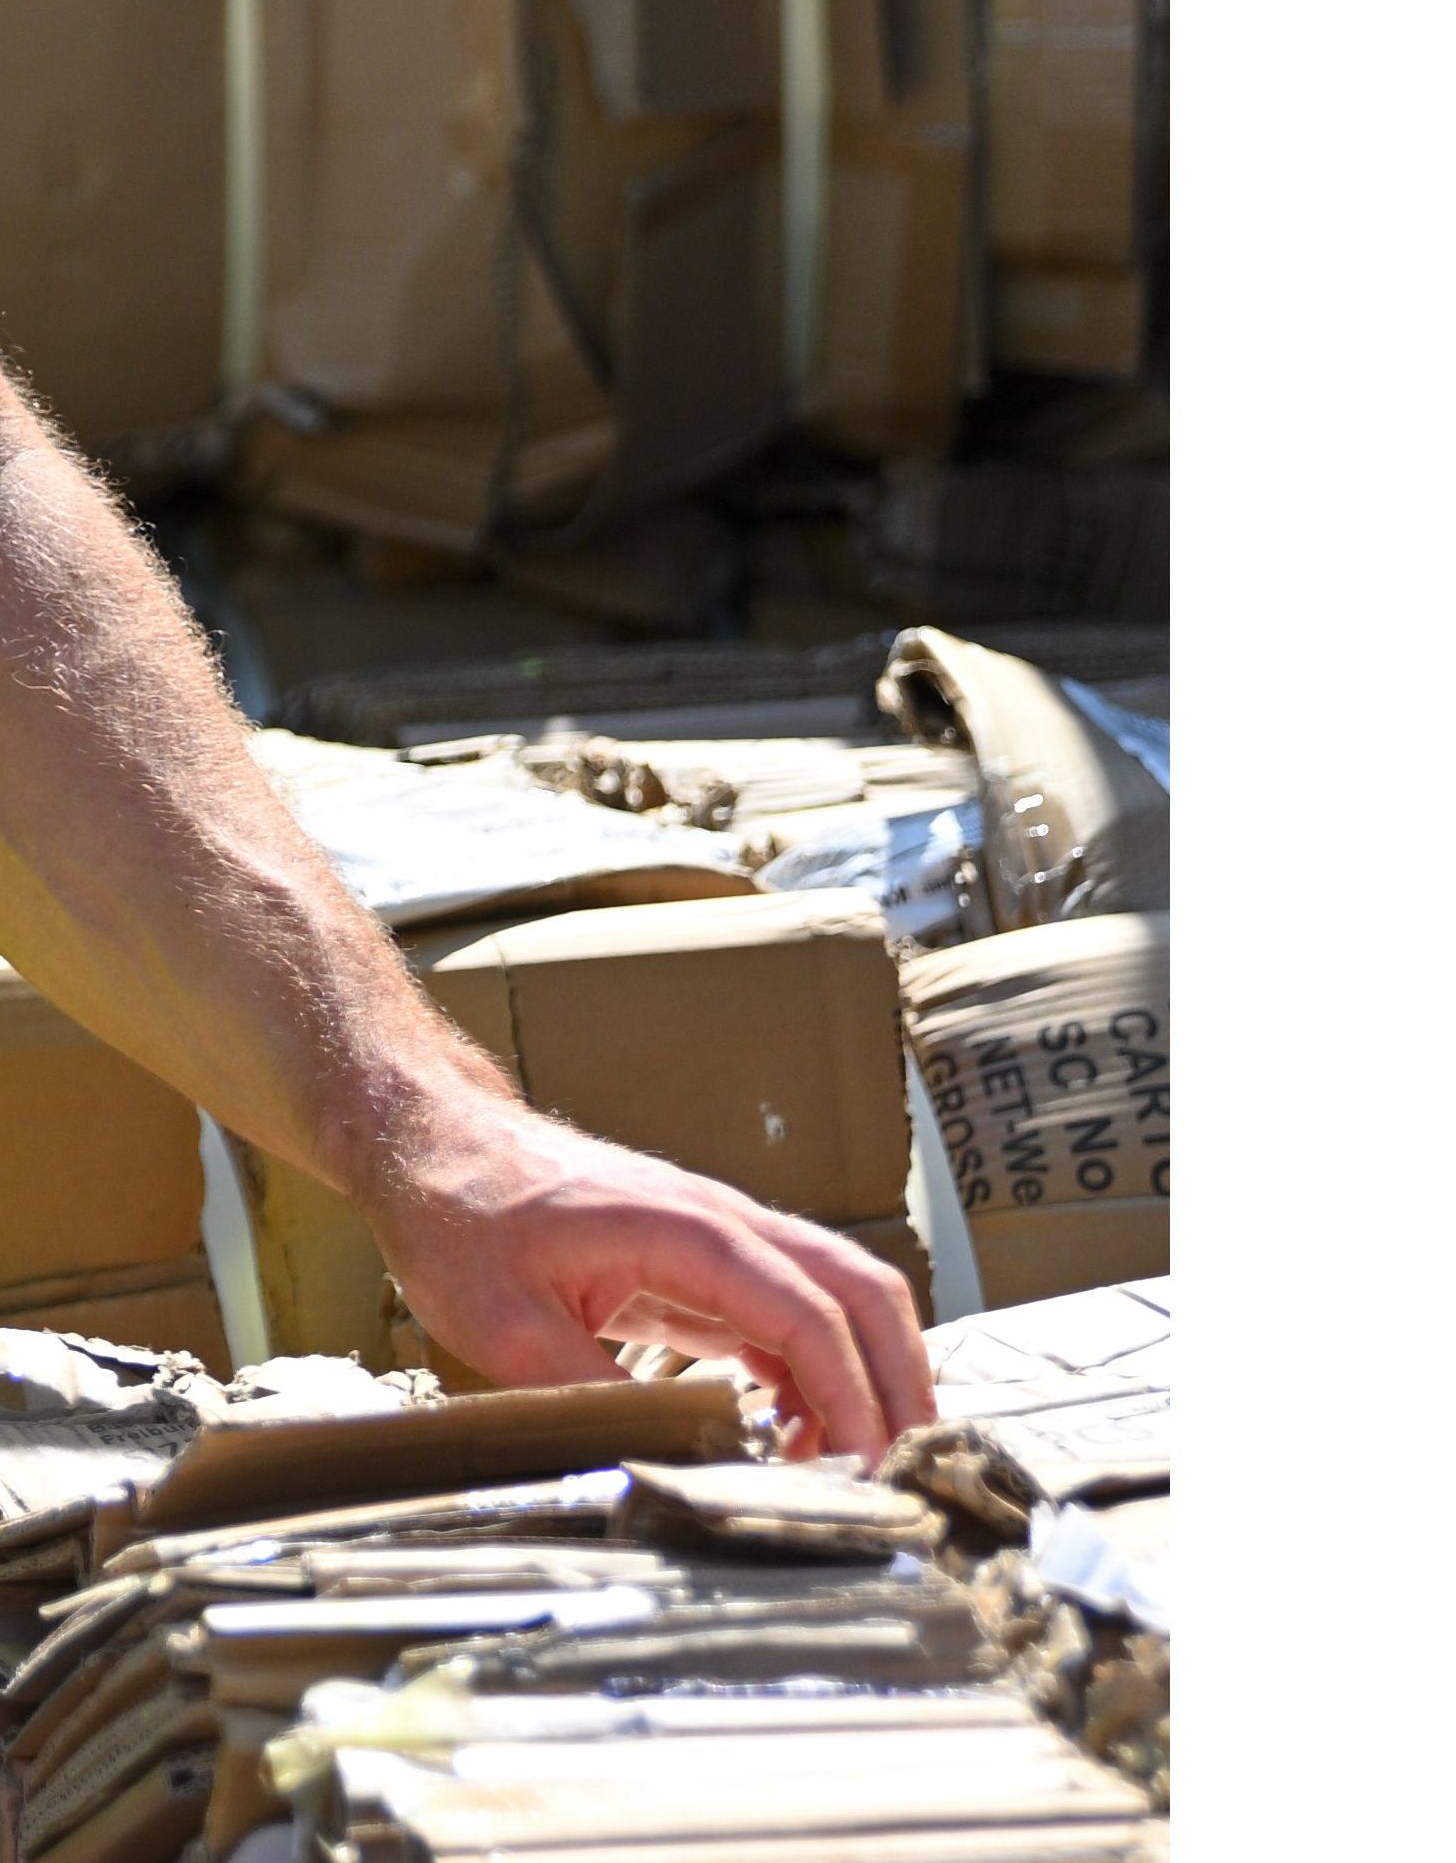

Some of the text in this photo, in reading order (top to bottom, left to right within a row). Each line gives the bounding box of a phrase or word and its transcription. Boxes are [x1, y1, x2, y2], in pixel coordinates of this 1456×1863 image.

[924, 1049, 992, 1211] GROSS
[1038, 1020, 1118, 1192] SC No
